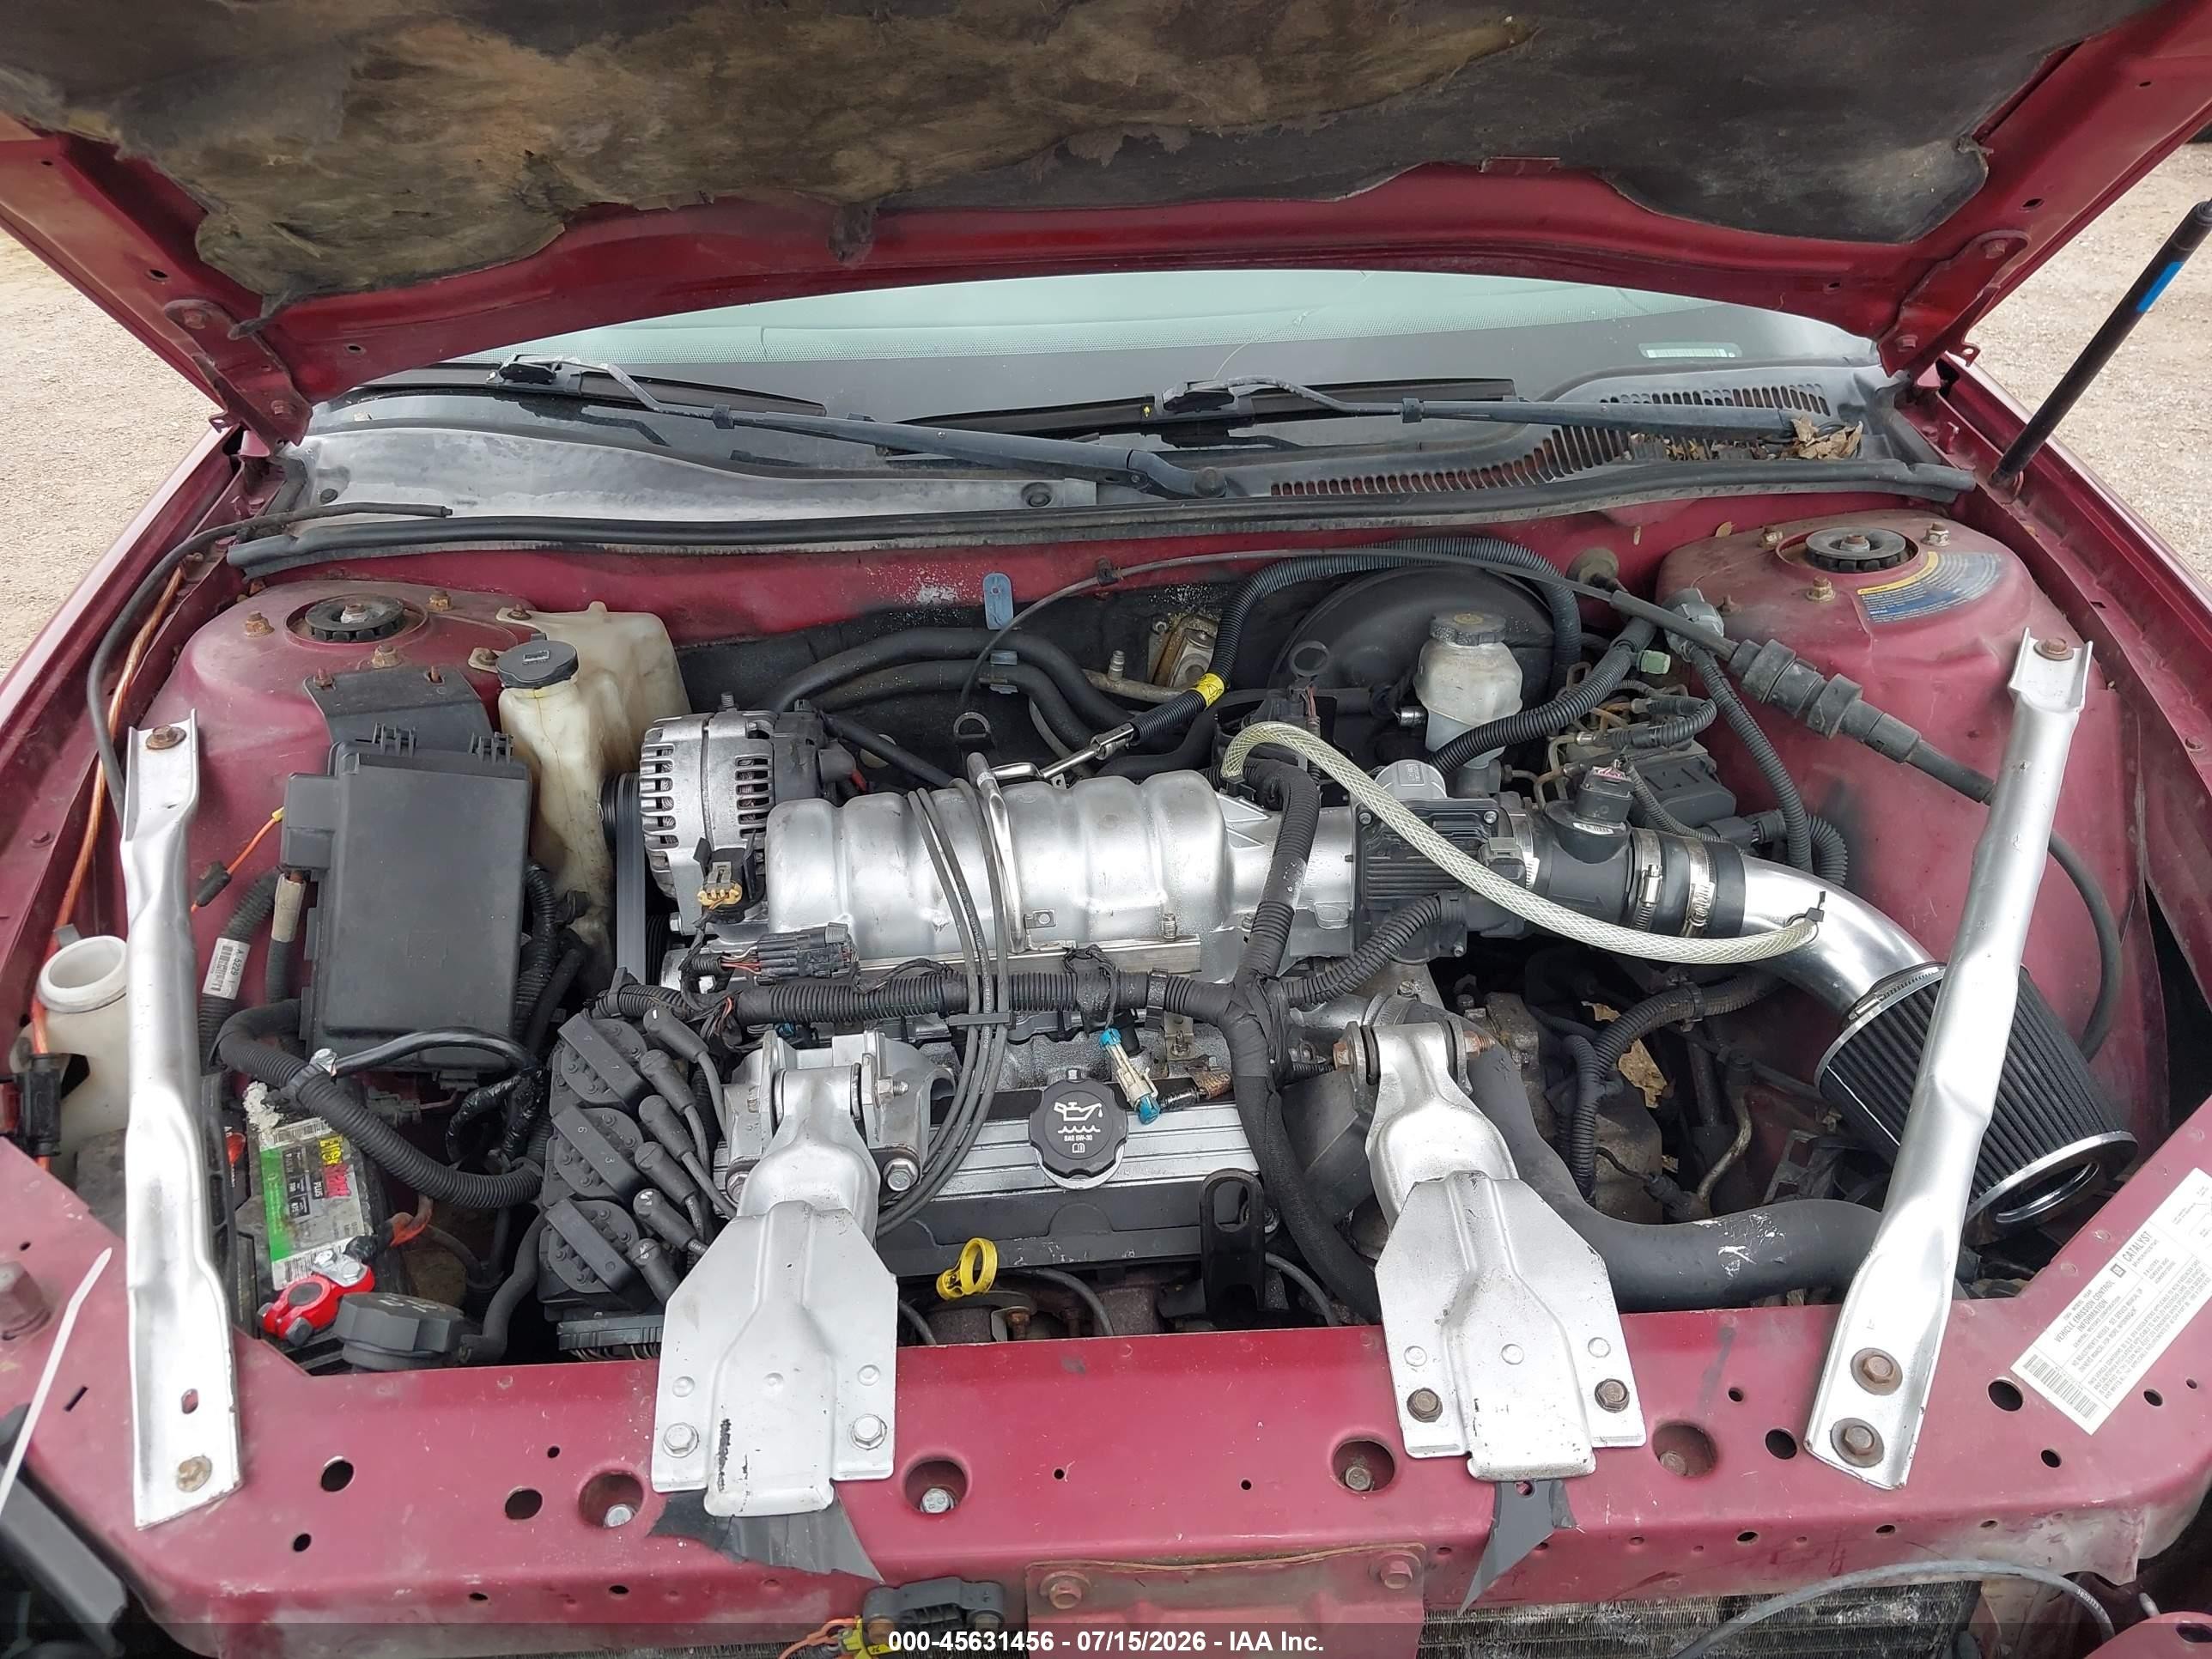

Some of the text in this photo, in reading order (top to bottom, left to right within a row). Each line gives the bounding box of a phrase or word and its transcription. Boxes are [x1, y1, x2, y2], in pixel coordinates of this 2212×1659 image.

[313, 1181, 323, 1197] PLUS
[2122, 1231, 2152, 1262] CATALYST
[2054, 1320, 2075, 1344] VEHICLE
[2072, 1298, 2096, 1324] EMISSION
[2092, 1278, 2115, 1302] CONTROL
[2076, 1297, 2108, 1333] INFORMATION
